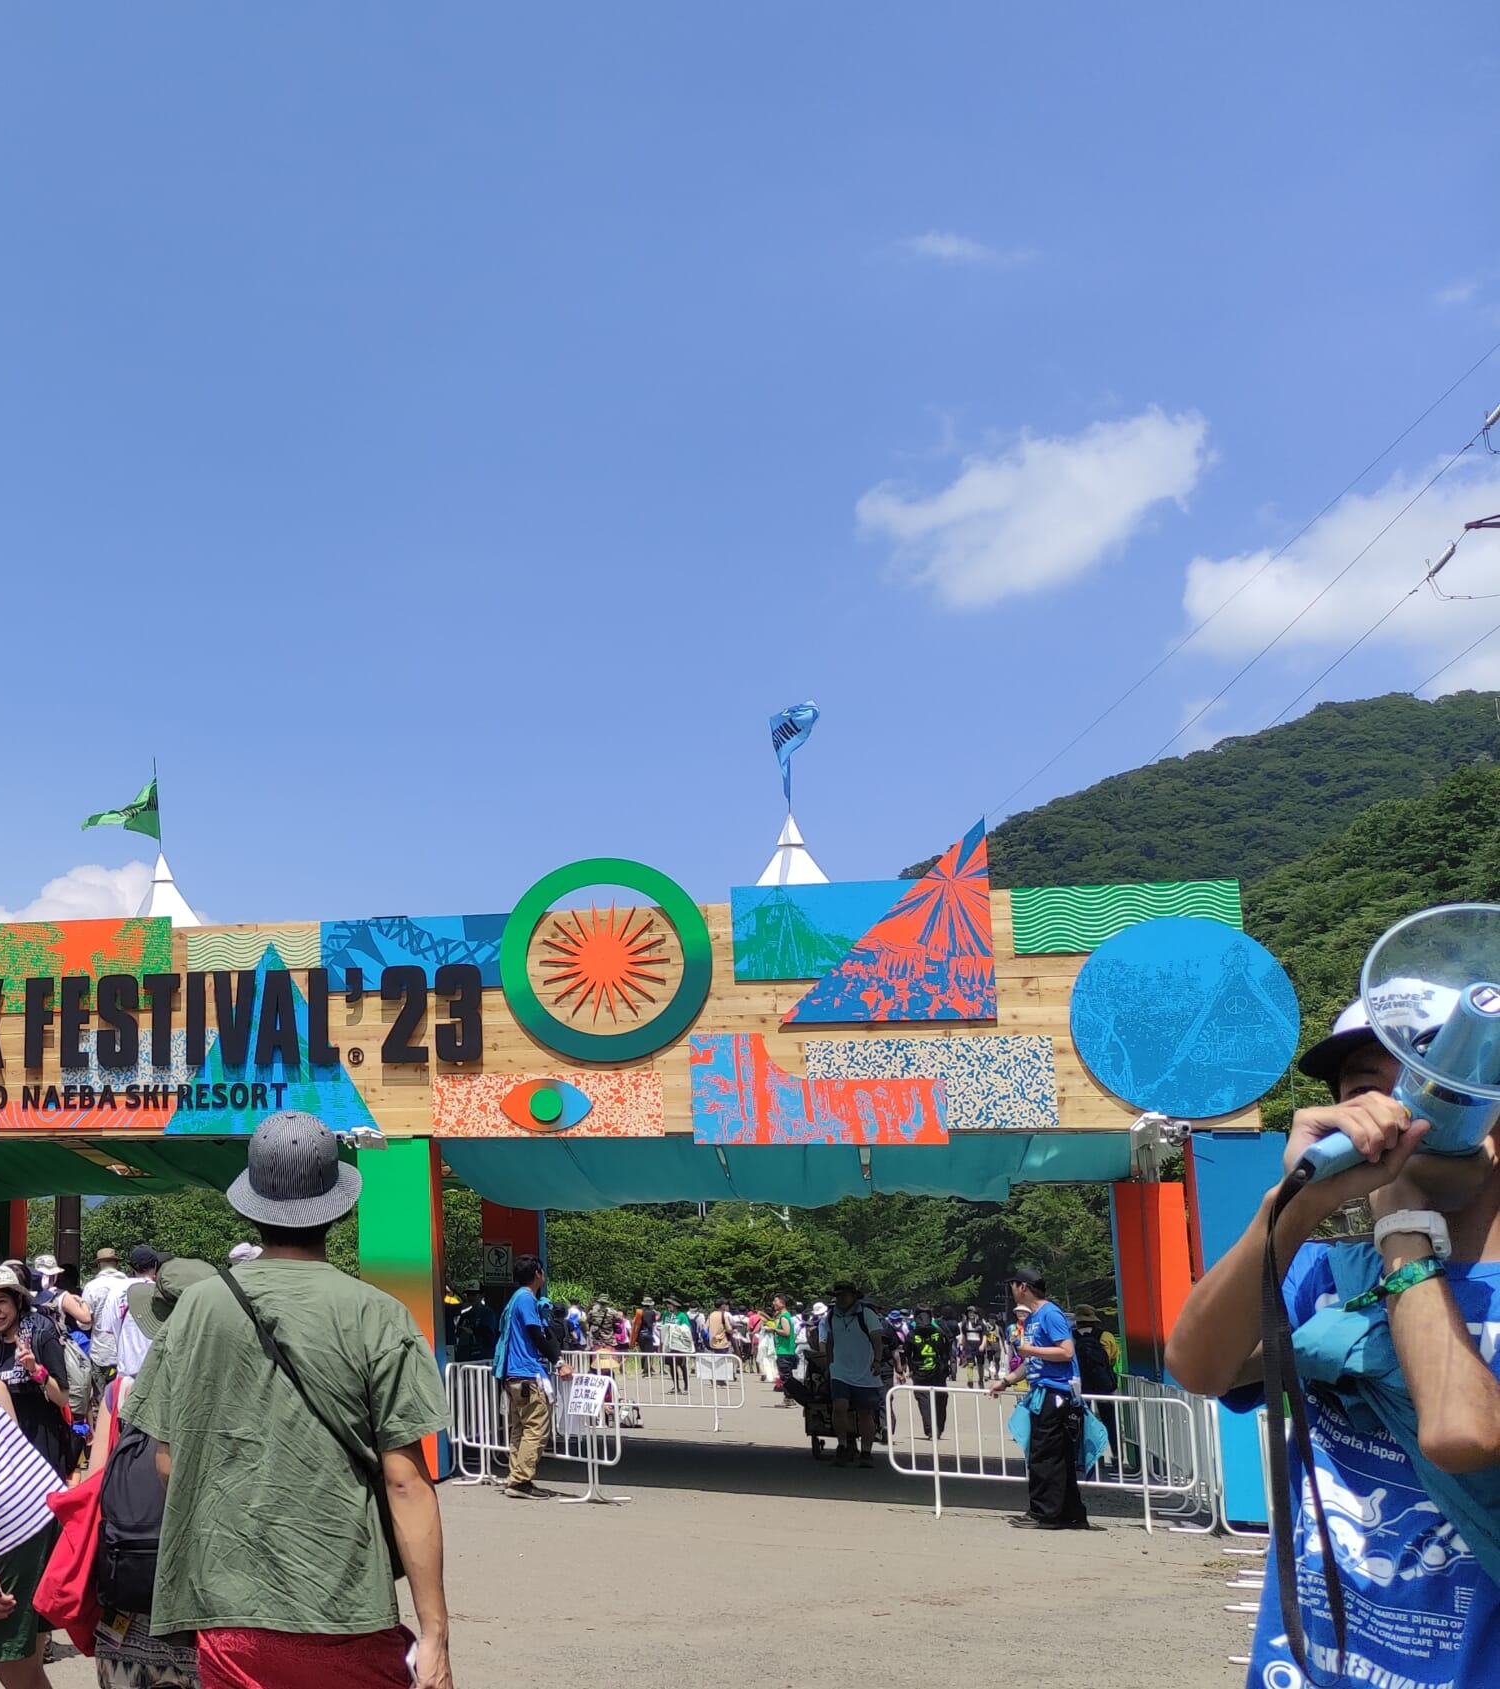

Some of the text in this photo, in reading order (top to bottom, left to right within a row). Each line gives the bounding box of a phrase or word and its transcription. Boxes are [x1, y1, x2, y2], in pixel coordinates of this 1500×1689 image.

[24, 968, 340, 1068] FESTIVAL
[22, 1084, 117, 1112] NAEBA
[125, 1084, 169, 1111] SKI
[177, 1082, 288, 1110] RESORT
[583, 1401, 599, 1414] ONLY
[1367, 1440, 1406, 1464] Japan
[1423, 1616, 1449, 1628] FIELD
[1450, 1620, 1464, 1630] OF
[1432, 1628, 1451, 1640] DAY
